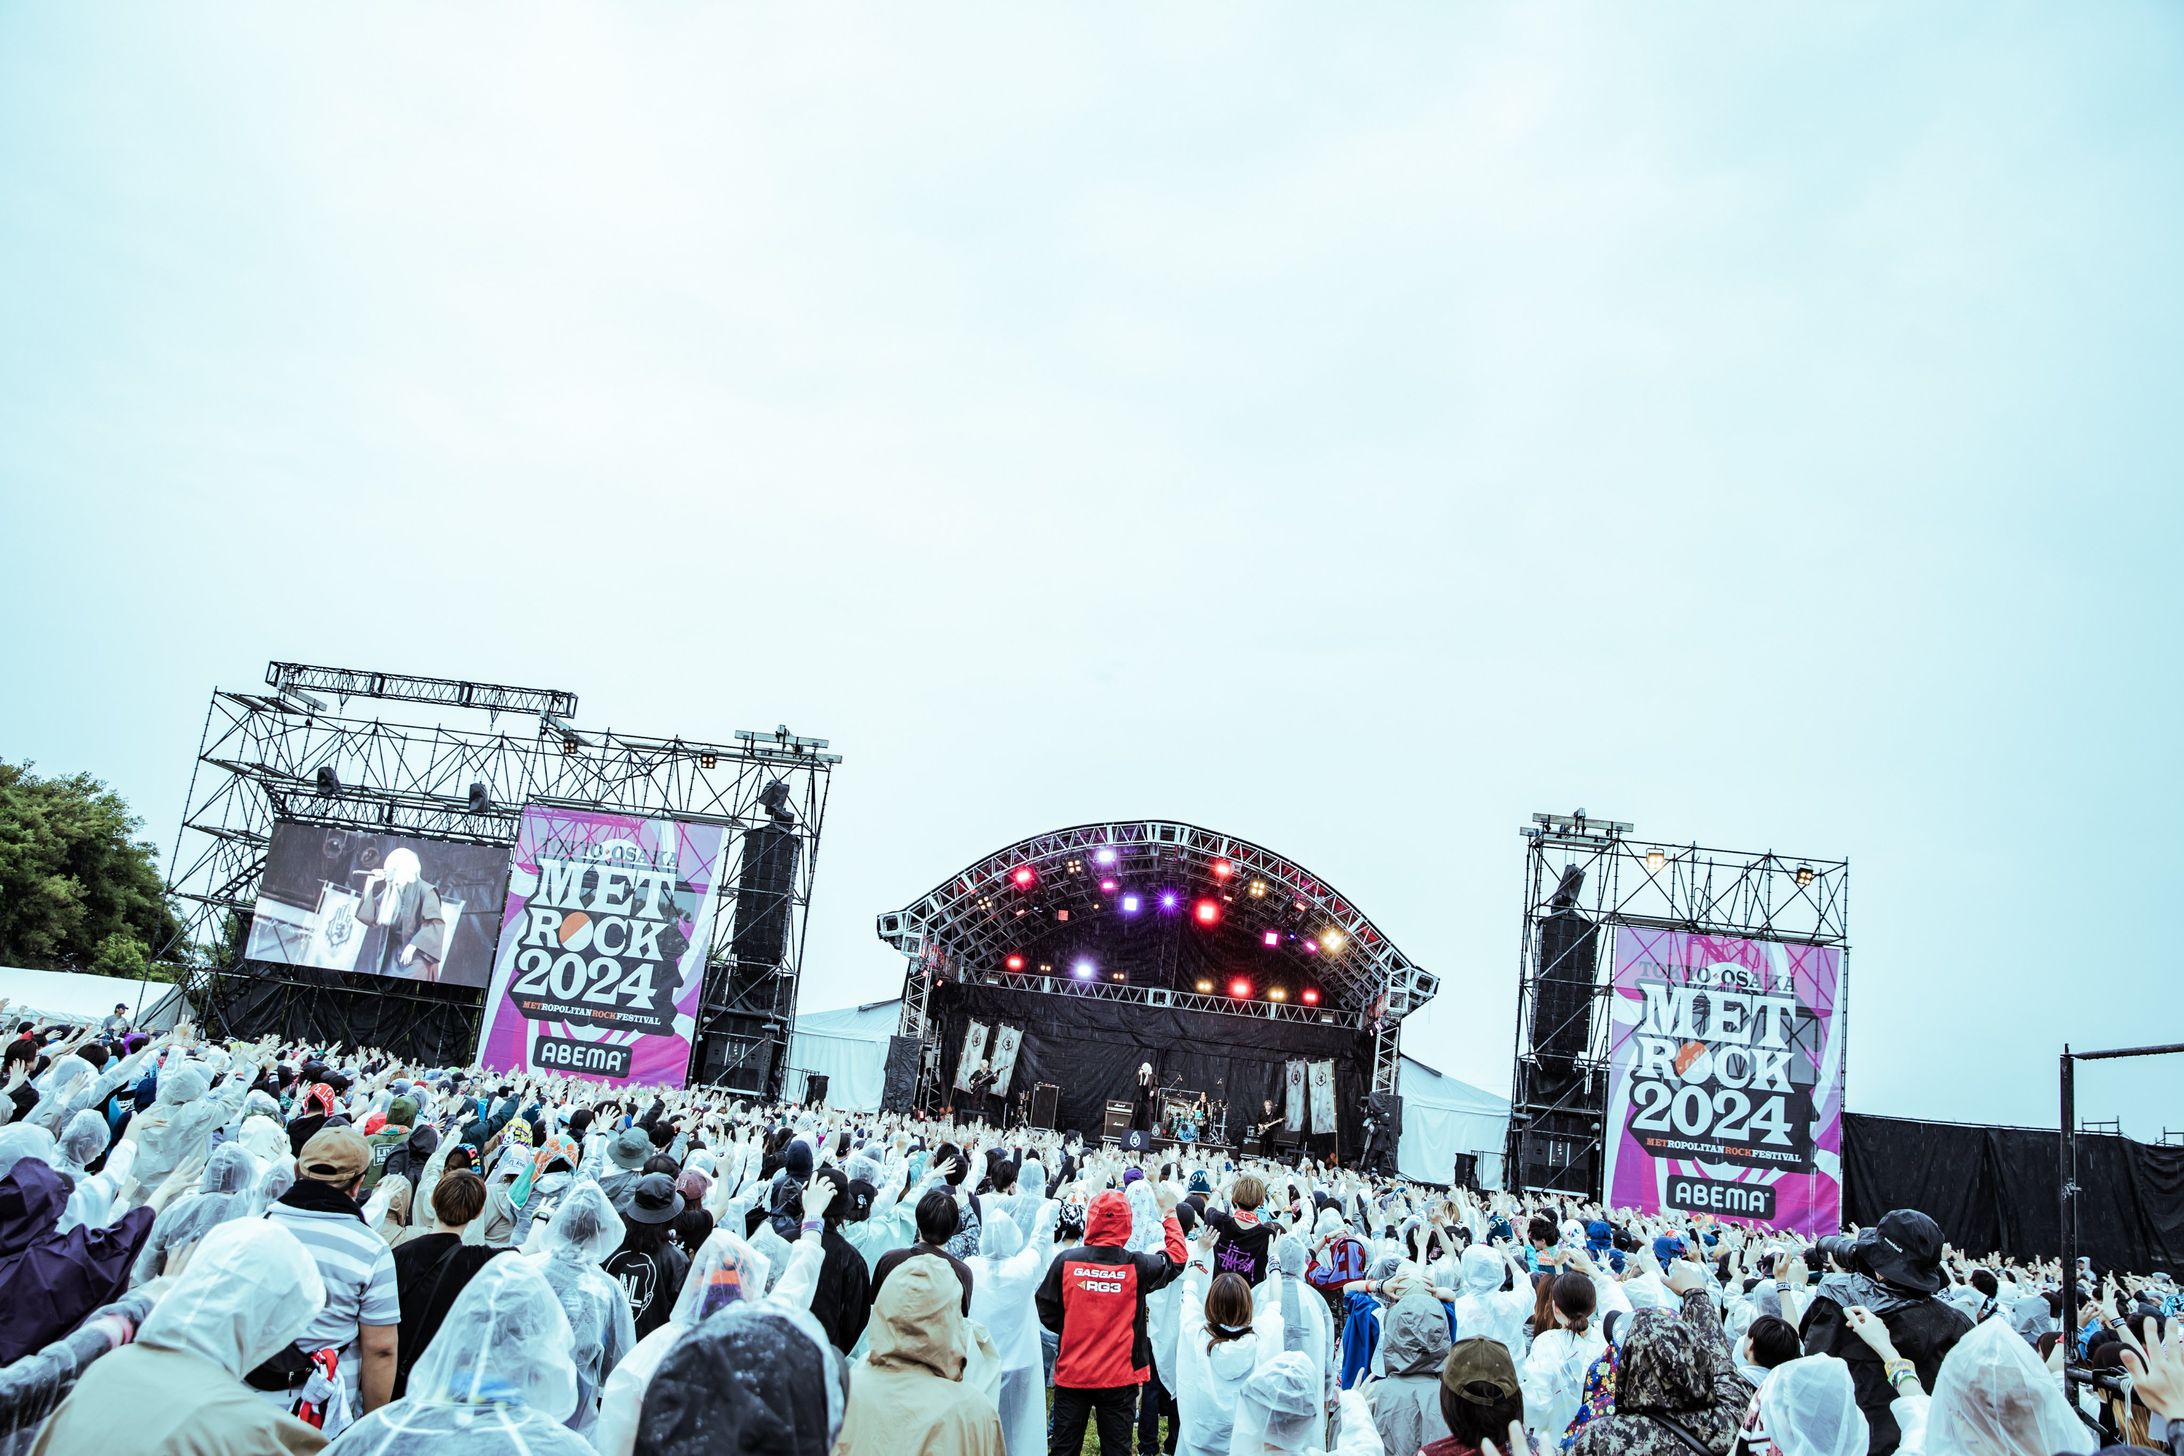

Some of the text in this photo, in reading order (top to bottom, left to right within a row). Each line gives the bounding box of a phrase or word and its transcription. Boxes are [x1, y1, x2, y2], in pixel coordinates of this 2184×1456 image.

[530, 857, 677, 920] MET
[522, 906, 669, 961] ROCK
[511, 948, 657, 1010] 2024
[1637, 983, 1796, 1049] MET
[541, 1042, 622, 1072] ABEMA
[1634, 1036, 1795, 1093] ROCK
[1632, 1080, 1793, 1146] 2024
[1675, 1182, 1766, 1213] ABEMA
[1073, 1268, 1126, 1280] GASGAS
[1086, 1280, 1121, 1293] RG3
